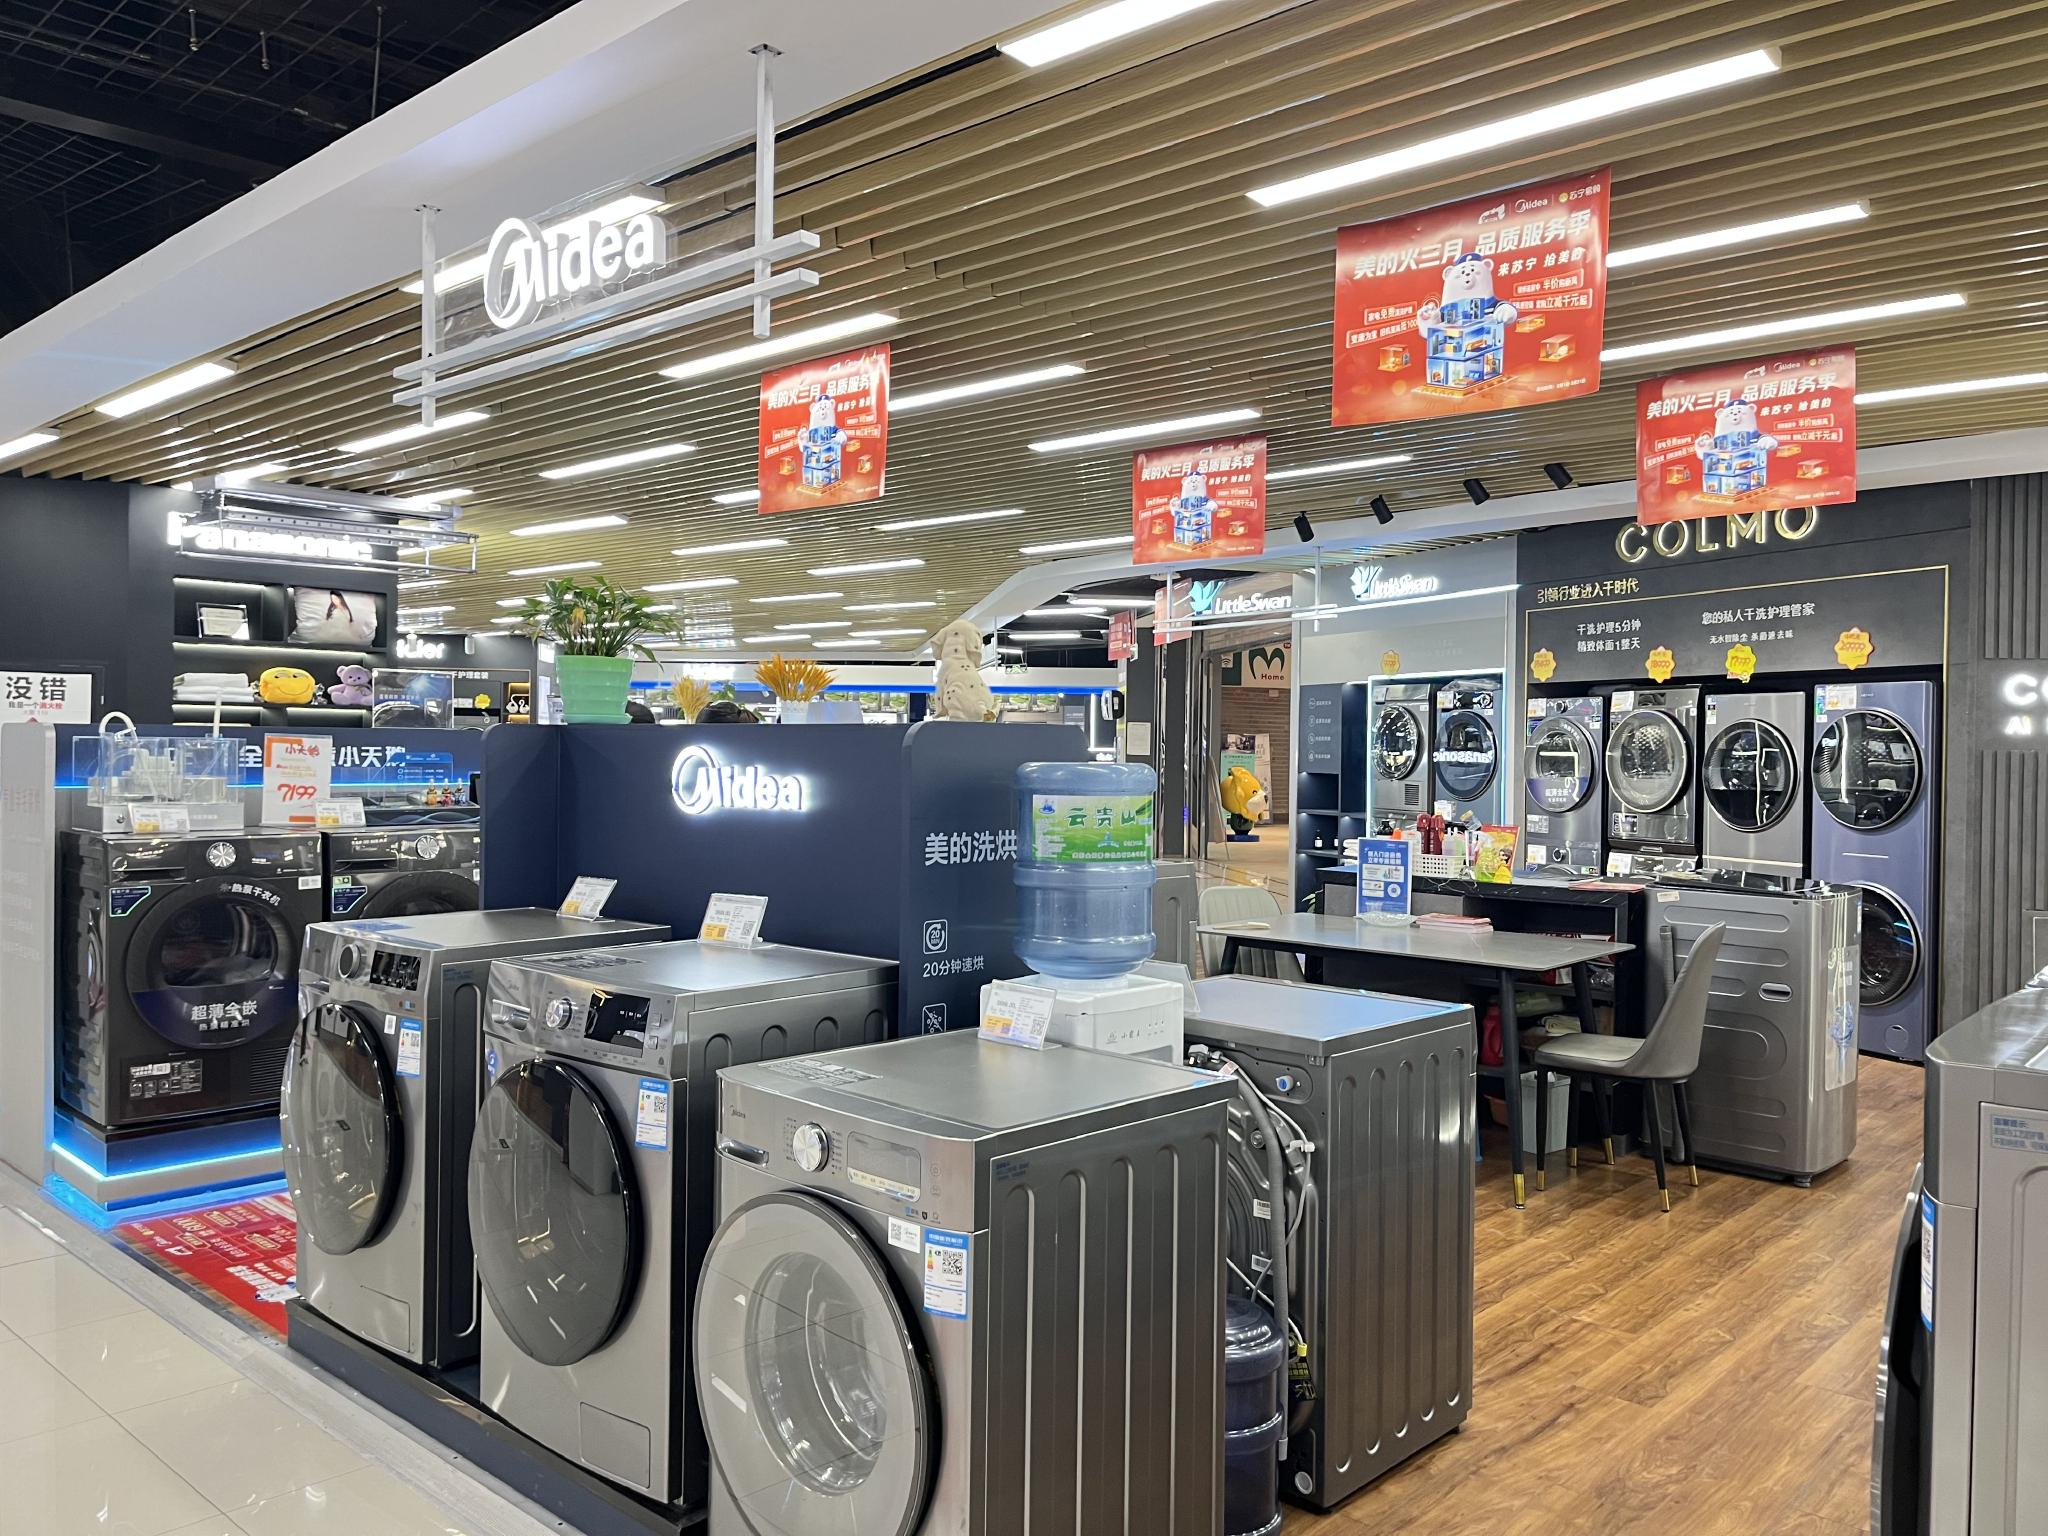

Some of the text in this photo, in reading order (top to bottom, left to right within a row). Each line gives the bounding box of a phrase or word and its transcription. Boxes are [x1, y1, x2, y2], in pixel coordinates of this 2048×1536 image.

[1515, 199, 1548, 213] Midea
[1353, 237, 1464, 281] 美的火三月
[1475, 209, 1591, 257] 品质服务季
[484, 213, 666, 330] Midea
[1615, 505, 1817, 563] COLMO
[1215, 592, 1292, 614] LittleSwan
[1701, 602, 1816, 625] 您的私人干洗护理管家
[1577, 619, 1642, 635] 干洗护理5分钟
[6, 676, 67, 701] 没错
[1261, 673, 1285, 681] Home
[2004, 673, 2048, 705] C
[277, 783, 317, 802] 7199
[671, 745, 813, 815] Midea
[1065, 805, 1136, 830] 云贵山
[924, 830, 1018, 866] 美的洗烘
[922, 955, 984, 977] 20分钟速烘
